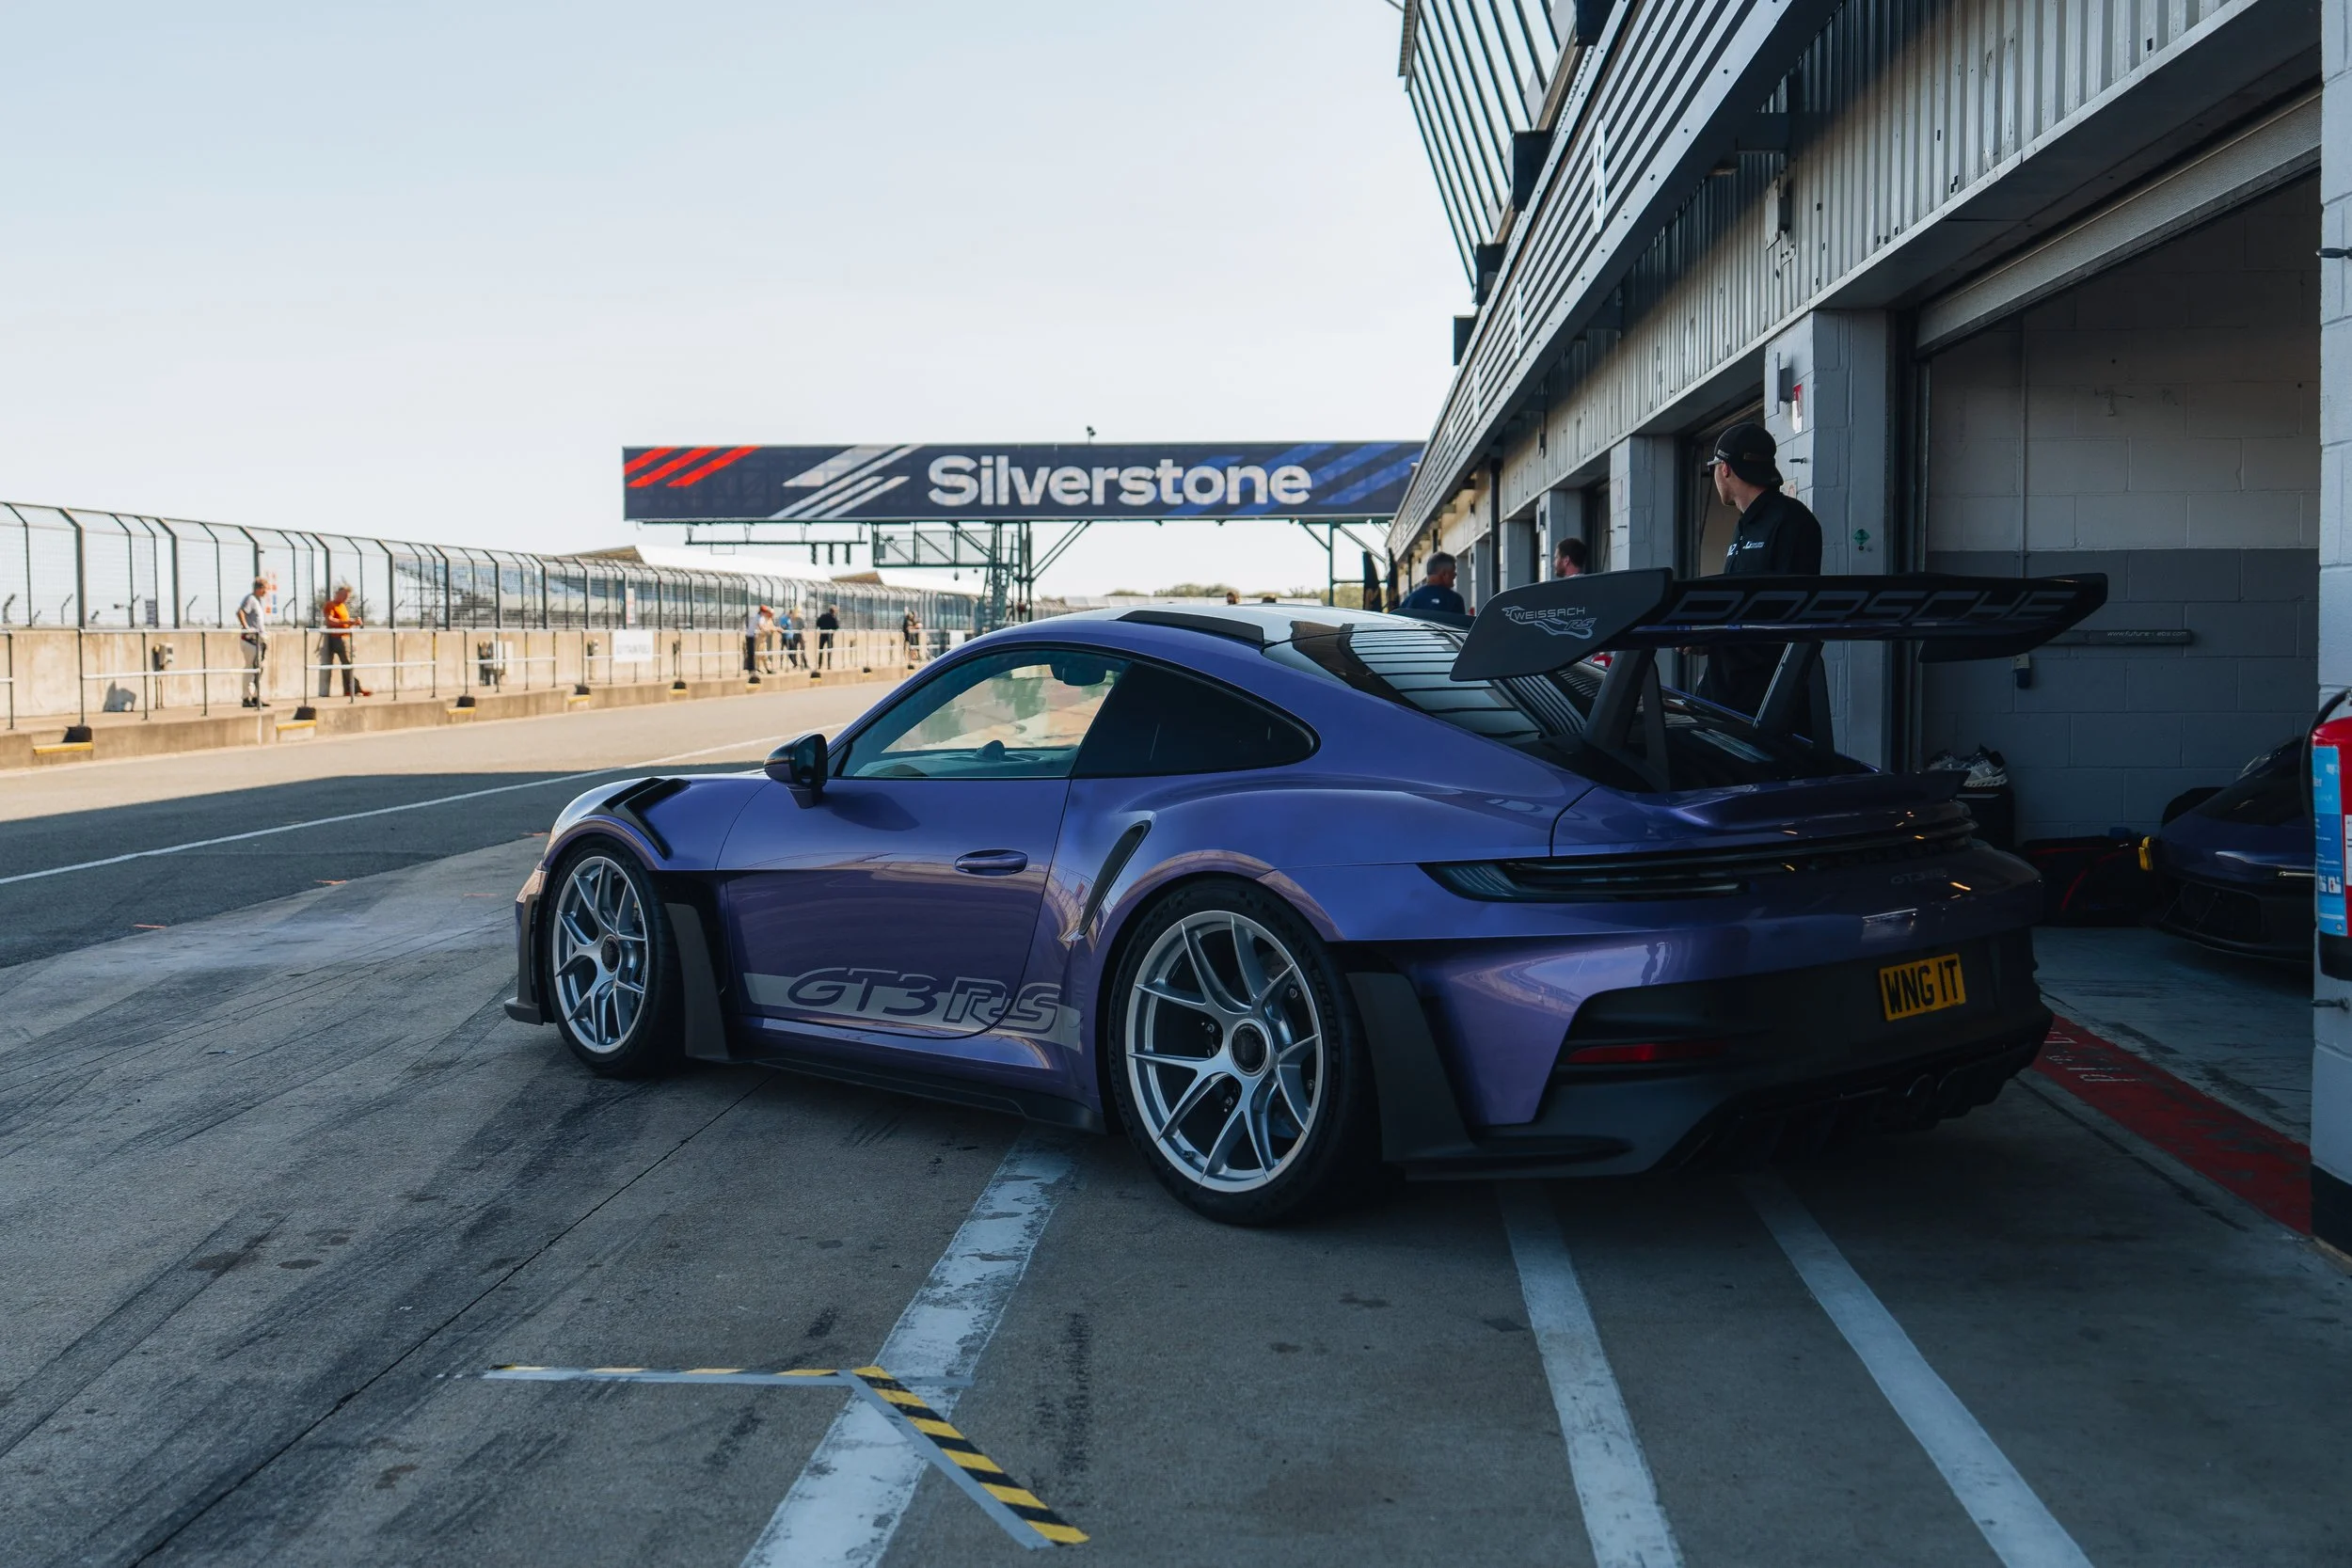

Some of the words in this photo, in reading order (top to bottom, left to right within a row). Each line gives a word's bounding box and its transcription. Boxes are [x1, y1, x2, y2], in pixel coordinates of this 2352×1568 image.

[1593, 119, 1605, 234] 8
[928, 454, 1312, 506] Silverstone
[1514, 607, 1585, 621] WEISSACH
[1564, 617, 1597, 631] RS
[1660, 590, 2078, 625] PORSCHE
[1883, 965, 1935, 1014] WNG
[1311, 967, 1340, 1064] MICHELIN
